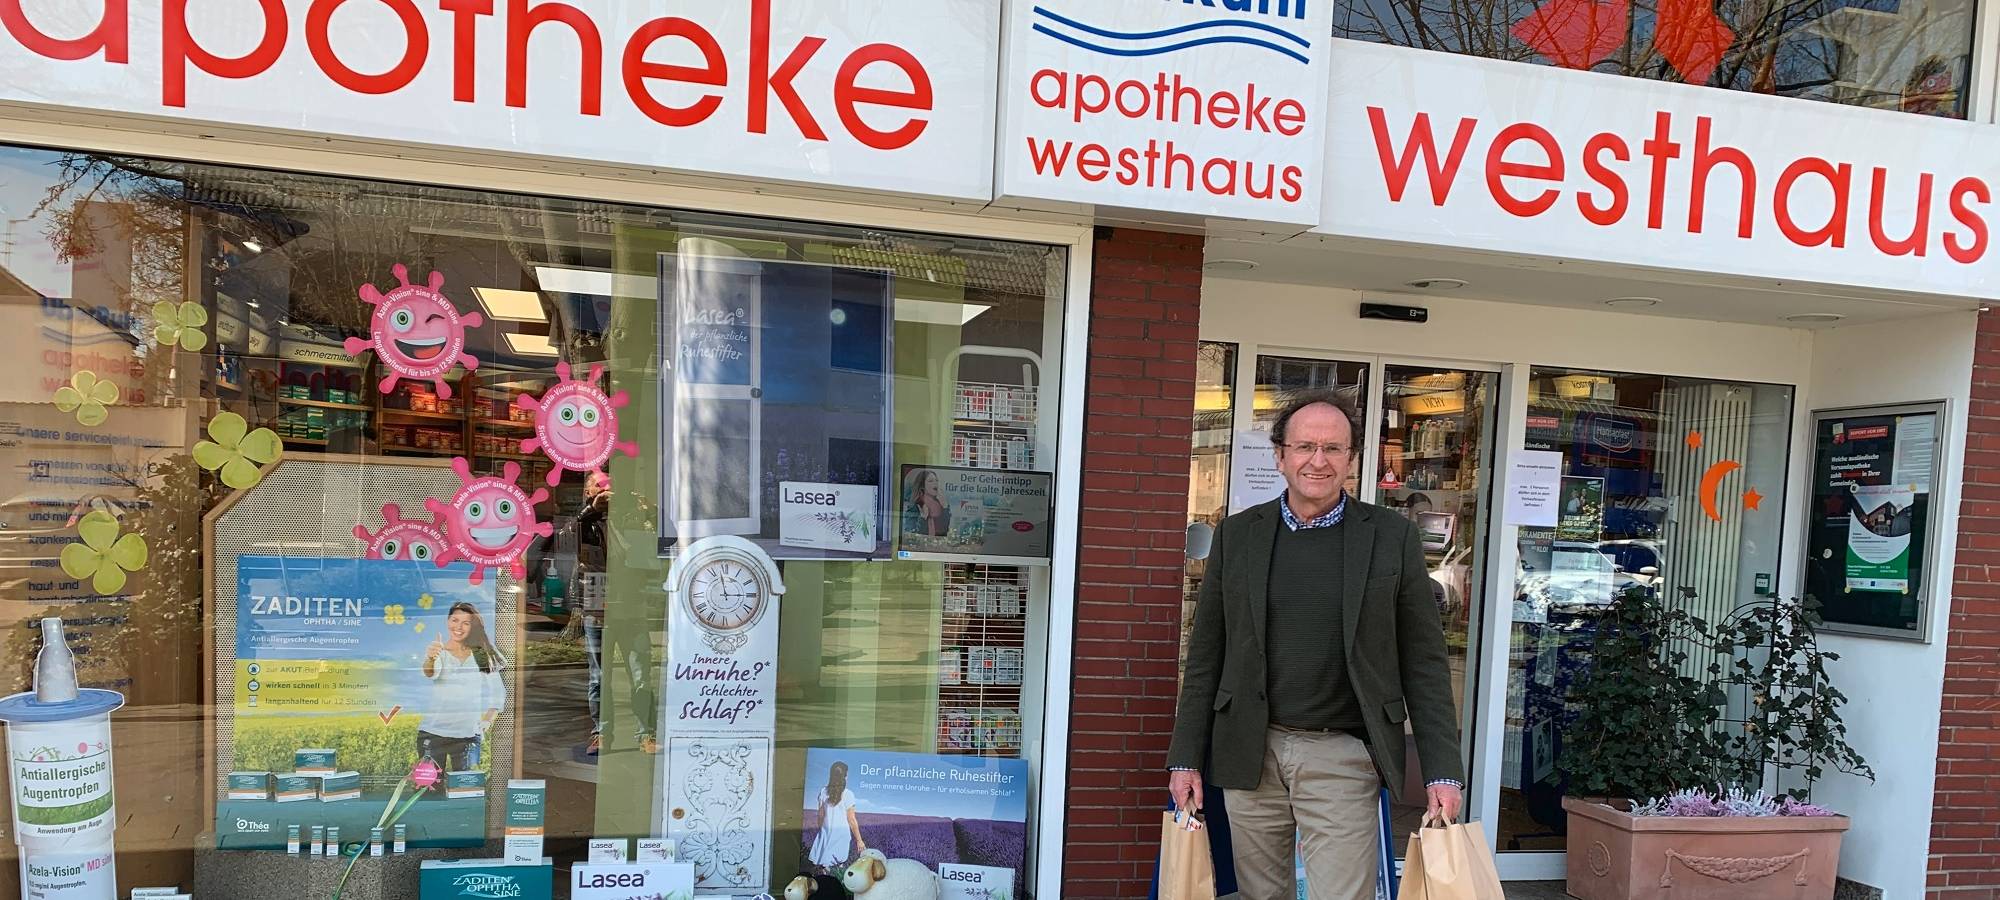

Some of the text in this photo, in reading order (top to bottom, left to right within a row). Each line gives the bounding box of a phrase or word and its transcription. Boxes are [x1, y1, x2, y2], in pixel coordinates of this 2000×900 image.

[0, 0, 933, 150] apotheke
[1030, 69, 1306, 136] apotheke
[1026, 137, 1303, 202] westhaus
[1366, 106, 1992, 264] westhaus
[438, 297, 450, 310] MD
[293, 347, 355, 363] schmerzmittel
[1422, 396, 1446, 409] VICHY
[960, 473, 1032, 488] Der Geheimtipp
[945, 482, 958, 492] für
[960, 483, 975, 493] die
[976, 484, 1000, 494] kalte
[513, 489, 525, 502] MD
[428, 528, 441, 540] MD
[303, 618, 337, 627] OPHTHA
[342, 619, 362, 627] SINE
[250, 634, 360, 646] Antiallergische Augentropfen
[692, 653, 731, 665] Innere
[338, 682, 369, 690] Minuten
[699, 683, 759, 697] Schlechter
[265, 697, 319, 706] langanhaltend
[344, 698, 377, 706] Stunden
[20, 759, 107, 781] Antiallergische
[859, 763, 1015, 784] Der pflanzliche Ruhestifter
[22, 781, 100, 802] Augentropfen
[859, 780, 881, 790] Gegen
[882, 782, 904, 790] innere
[905, 782, 931, 792] Unruhe
[937, 784, 947, 793] für
[948, 786, 989, 796] erholsamen
[36, 818, 103, 836] Anwendung am Auge
[248, 821, 270, 830] Théa
[86, 858, 101, 872] MD
[466, 883, 521, 892] OPHTHA
[493, 889, 521, 897] SINE
